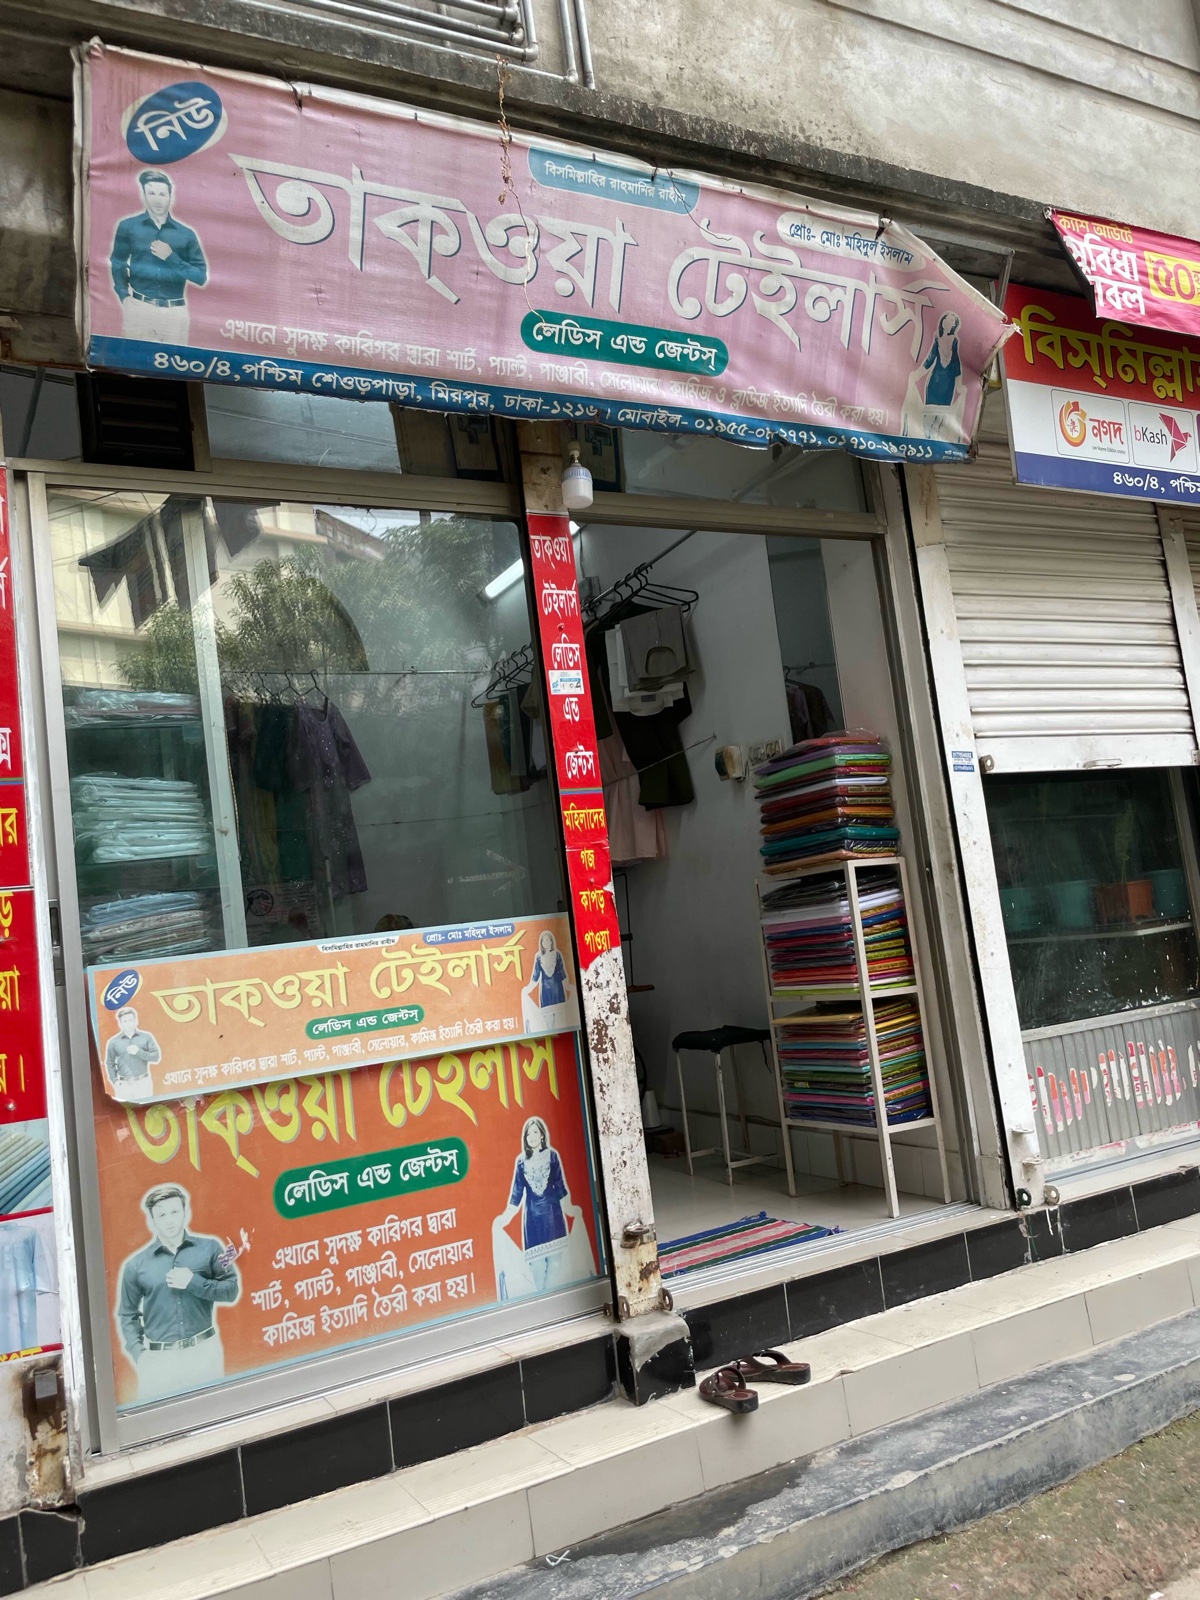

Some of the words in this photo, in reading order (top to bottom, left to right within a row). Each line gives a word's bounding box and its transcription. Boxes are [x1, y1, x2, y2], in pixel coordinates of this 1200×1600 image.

[134, 97, 212, 151] নিউ
[544, 160, 606, 188] বিসমিল্লাহির
[609, 178, 655, 198] রাহমানির
[1057, 214, 1090, 232] ক্যাশ
[1091, 221, 1133, 244] আউটে
[820, 230, 840, 248] মোঃ
[844, 232, 878, 258] মহিদুল
[879, 240, 915, 266] ইসলাম
[669, 218, 950, 363] টেইলার্স
[1153, 258, 1195, 300] ৫০
[532, 319, 602, 350] লেডিস
[610, 335, 648, 354] এন্ড
[220, 318, 277, 345] এখানে
[283, 326, 328, 356] সুদক্ষ
[334, 330, 400, 362] কারিগর
[406, 343, 441, 367] দ্বারা
[446, 347, 482, 376] শার্ট,
[489, 354, 533, 382] প্যান্ট,
[539, 361, 595, 388] পাঞ্জাবী,
[669, 376, 713, 403] কামিজ
[715, 387, 727, 404] ও
[730, 386, 768, 411] ব্লাউজ
[772, 390, 808, 416] ইত্যাদি
[839, 404, 865, 423] করা
[312, 371, 422, 403] শেওড়পাড়া,
[430, 380, 496, 412] মিরপুর,
[1089, 418, 1124, 445] নগদ
[1133, 424, 1168, 445] bKash
[1113, 471, 1165, 494] ৪৬০/৪,
[541, 579, 578, 620] টেইলার্স
[551, 632, 582, 670] লেডিস
[562, 696, 580, 725] এন্ড
[563, 801, 606, 833] মহিলাদের
[580, 847, 596, 871] গজ
[579, 888, 606, 915] কাপড়
[488, 924, 513, 936] ইসলাম
[584, 928, 611, 953] পাওয়া
[369, 929, 527, 999] টেইলার্স
[106, 973, 139, 1005] নিউ
[312, 1018, 352, 1035] লেডিস
[356, 1015, 378, 1029] এন্ড
[163, 1069, 192, 1086] এখানে
[194, 1064, 218, 1085] সুদক্ষ
[220, 1056, 257, 1076] কারিগর
[331, 1037, 365, 1056] পাঞ্জাবী,
[410, 1027, 437, 1045] কামিজ
[438, 1023, 463, 1041] ইত্যাদি
[464, 1018, 484, 1036] তৈরী
[485, 1020, 501, 1032] করা
[284, 1169, 349, 1206] লেডিস
[357, 1163, 392, 1189] এন্ড
[272, 1239, 319, 1270] এখানে
[324, 1229, 362, 1265] সুদক্ষ
[366, 1214, 423, 1247] কারিগর
[426, 1207, 457, 1235] দ্বারা
[251, 1279, 290, 1312] শার্ট,
[294, 1267, 341, 1301] প্যান্ট,
[345, 1250, 404, 1288] পাঞ্জাবী,
[408, 1238, 474, 1274] সেলোয়ার
[262, 1311, 316, 1347] কামিজ
[320, 1293, 368, 1334] ইত্যাদি
[371, 1283, 408, 1319] তৈরী
[412, 1281, 442, 1307] করা
